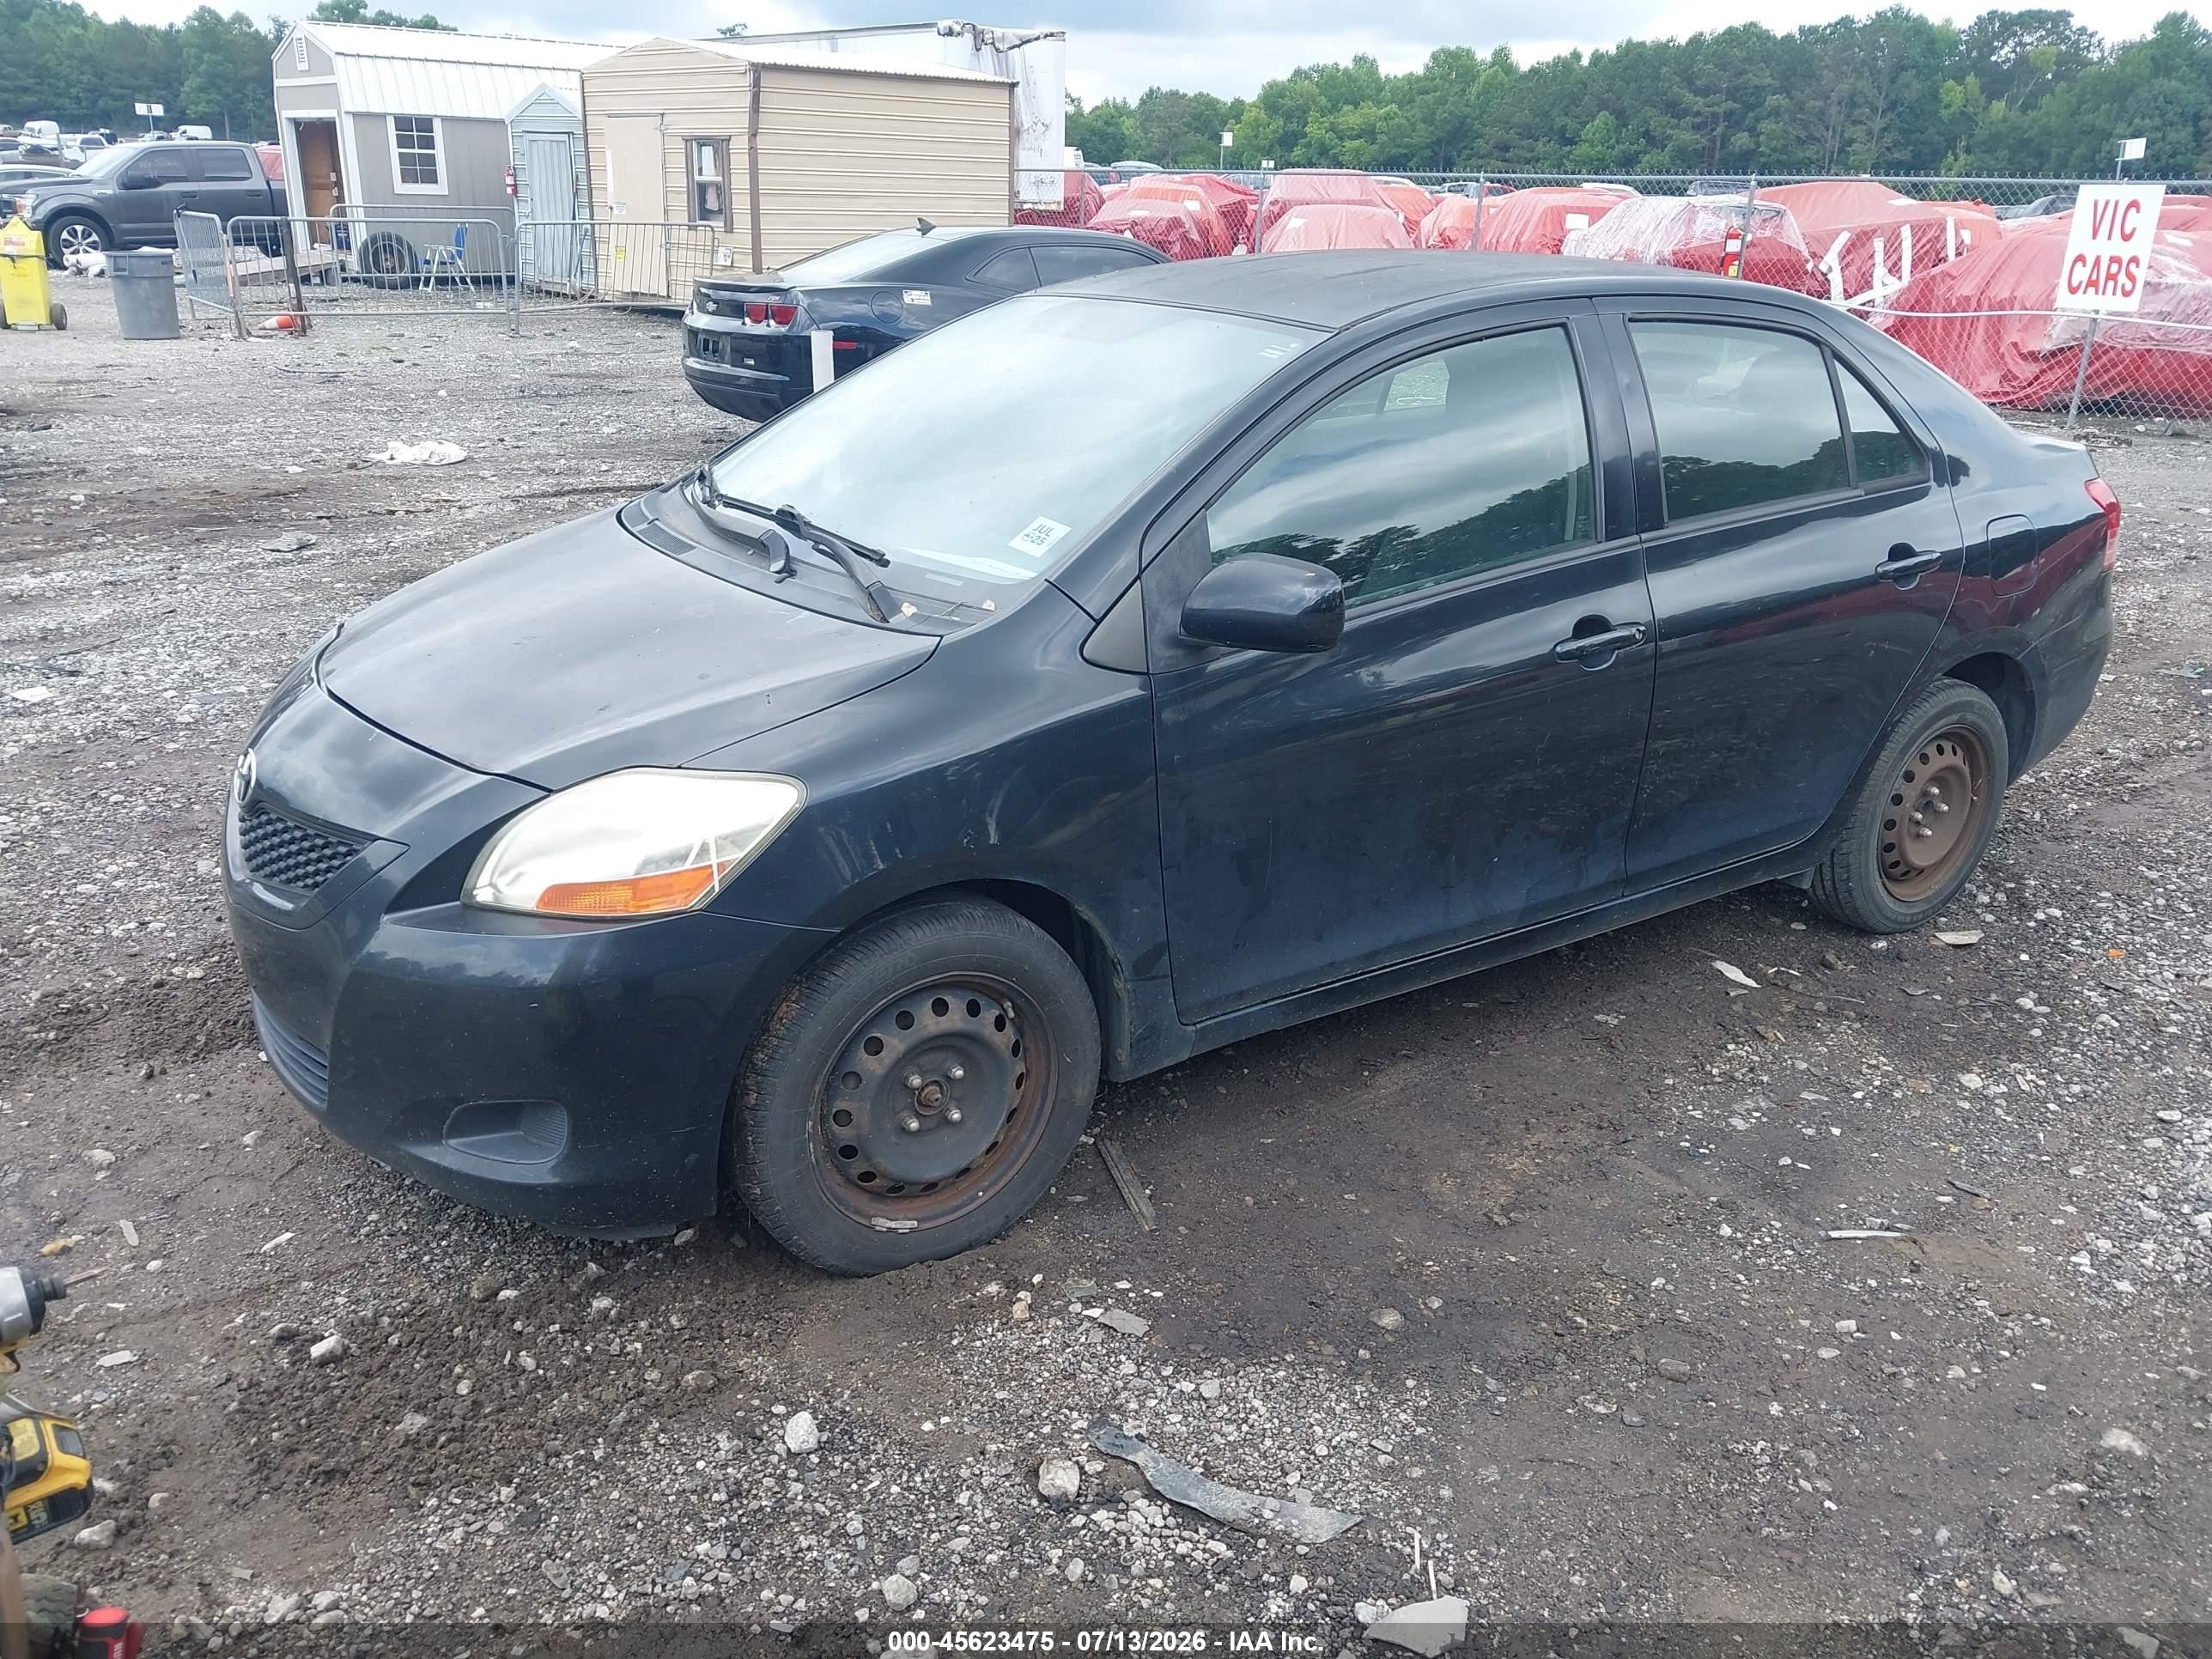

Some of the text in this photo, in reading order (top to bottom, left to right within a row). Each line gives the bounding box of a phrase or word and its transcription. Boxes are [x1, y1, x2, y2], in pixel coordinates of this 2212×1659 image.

[2092, 198, 2142, 242] VIC
[2067, 252, 2141, 298] CARS
[1030, 535, 1047, 546] 25
[1032, 523, 1054, 538] JUL
